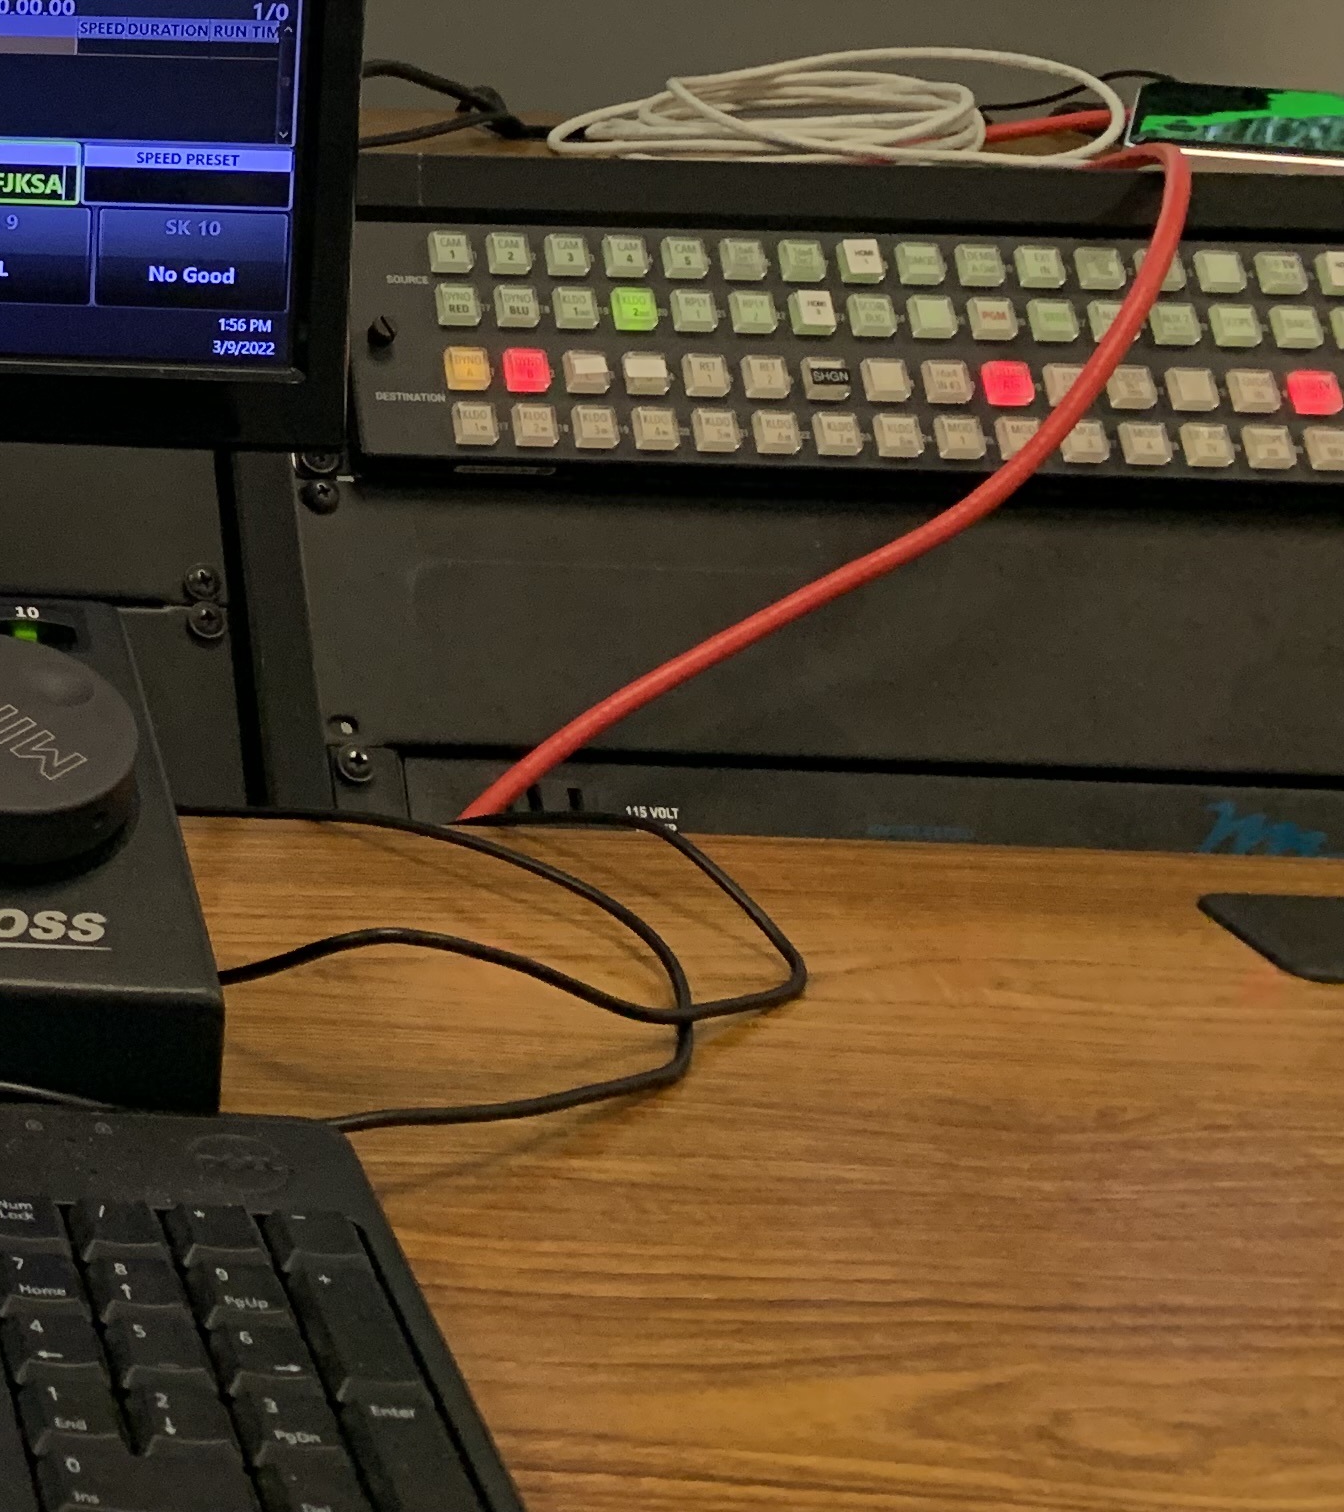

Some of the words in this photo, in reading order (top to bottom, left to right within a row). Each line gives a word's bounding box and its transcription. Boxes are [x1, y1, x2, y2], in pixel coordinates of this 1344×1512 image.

[253, 2, 289, 20] 1/0
[137, 150, 182, 166] SPEED
[187, 152, 240, 168] PRESET
[148, 265, 177, 283] No
[181, 266, 235, 285] Good
[386, 274, 430, 285] SOURCE
[218, 318, 246, 334] 1:56
[249, 319, 273, 334] PM
[212, 339, 275, 357] 3/9/2022
[813, 370, 849, 382] SHGN
[375, 392, 446, 402] DESTINATION
[626, 806, 647, 818] 115
[649, 806, 679, 819] VOLT
